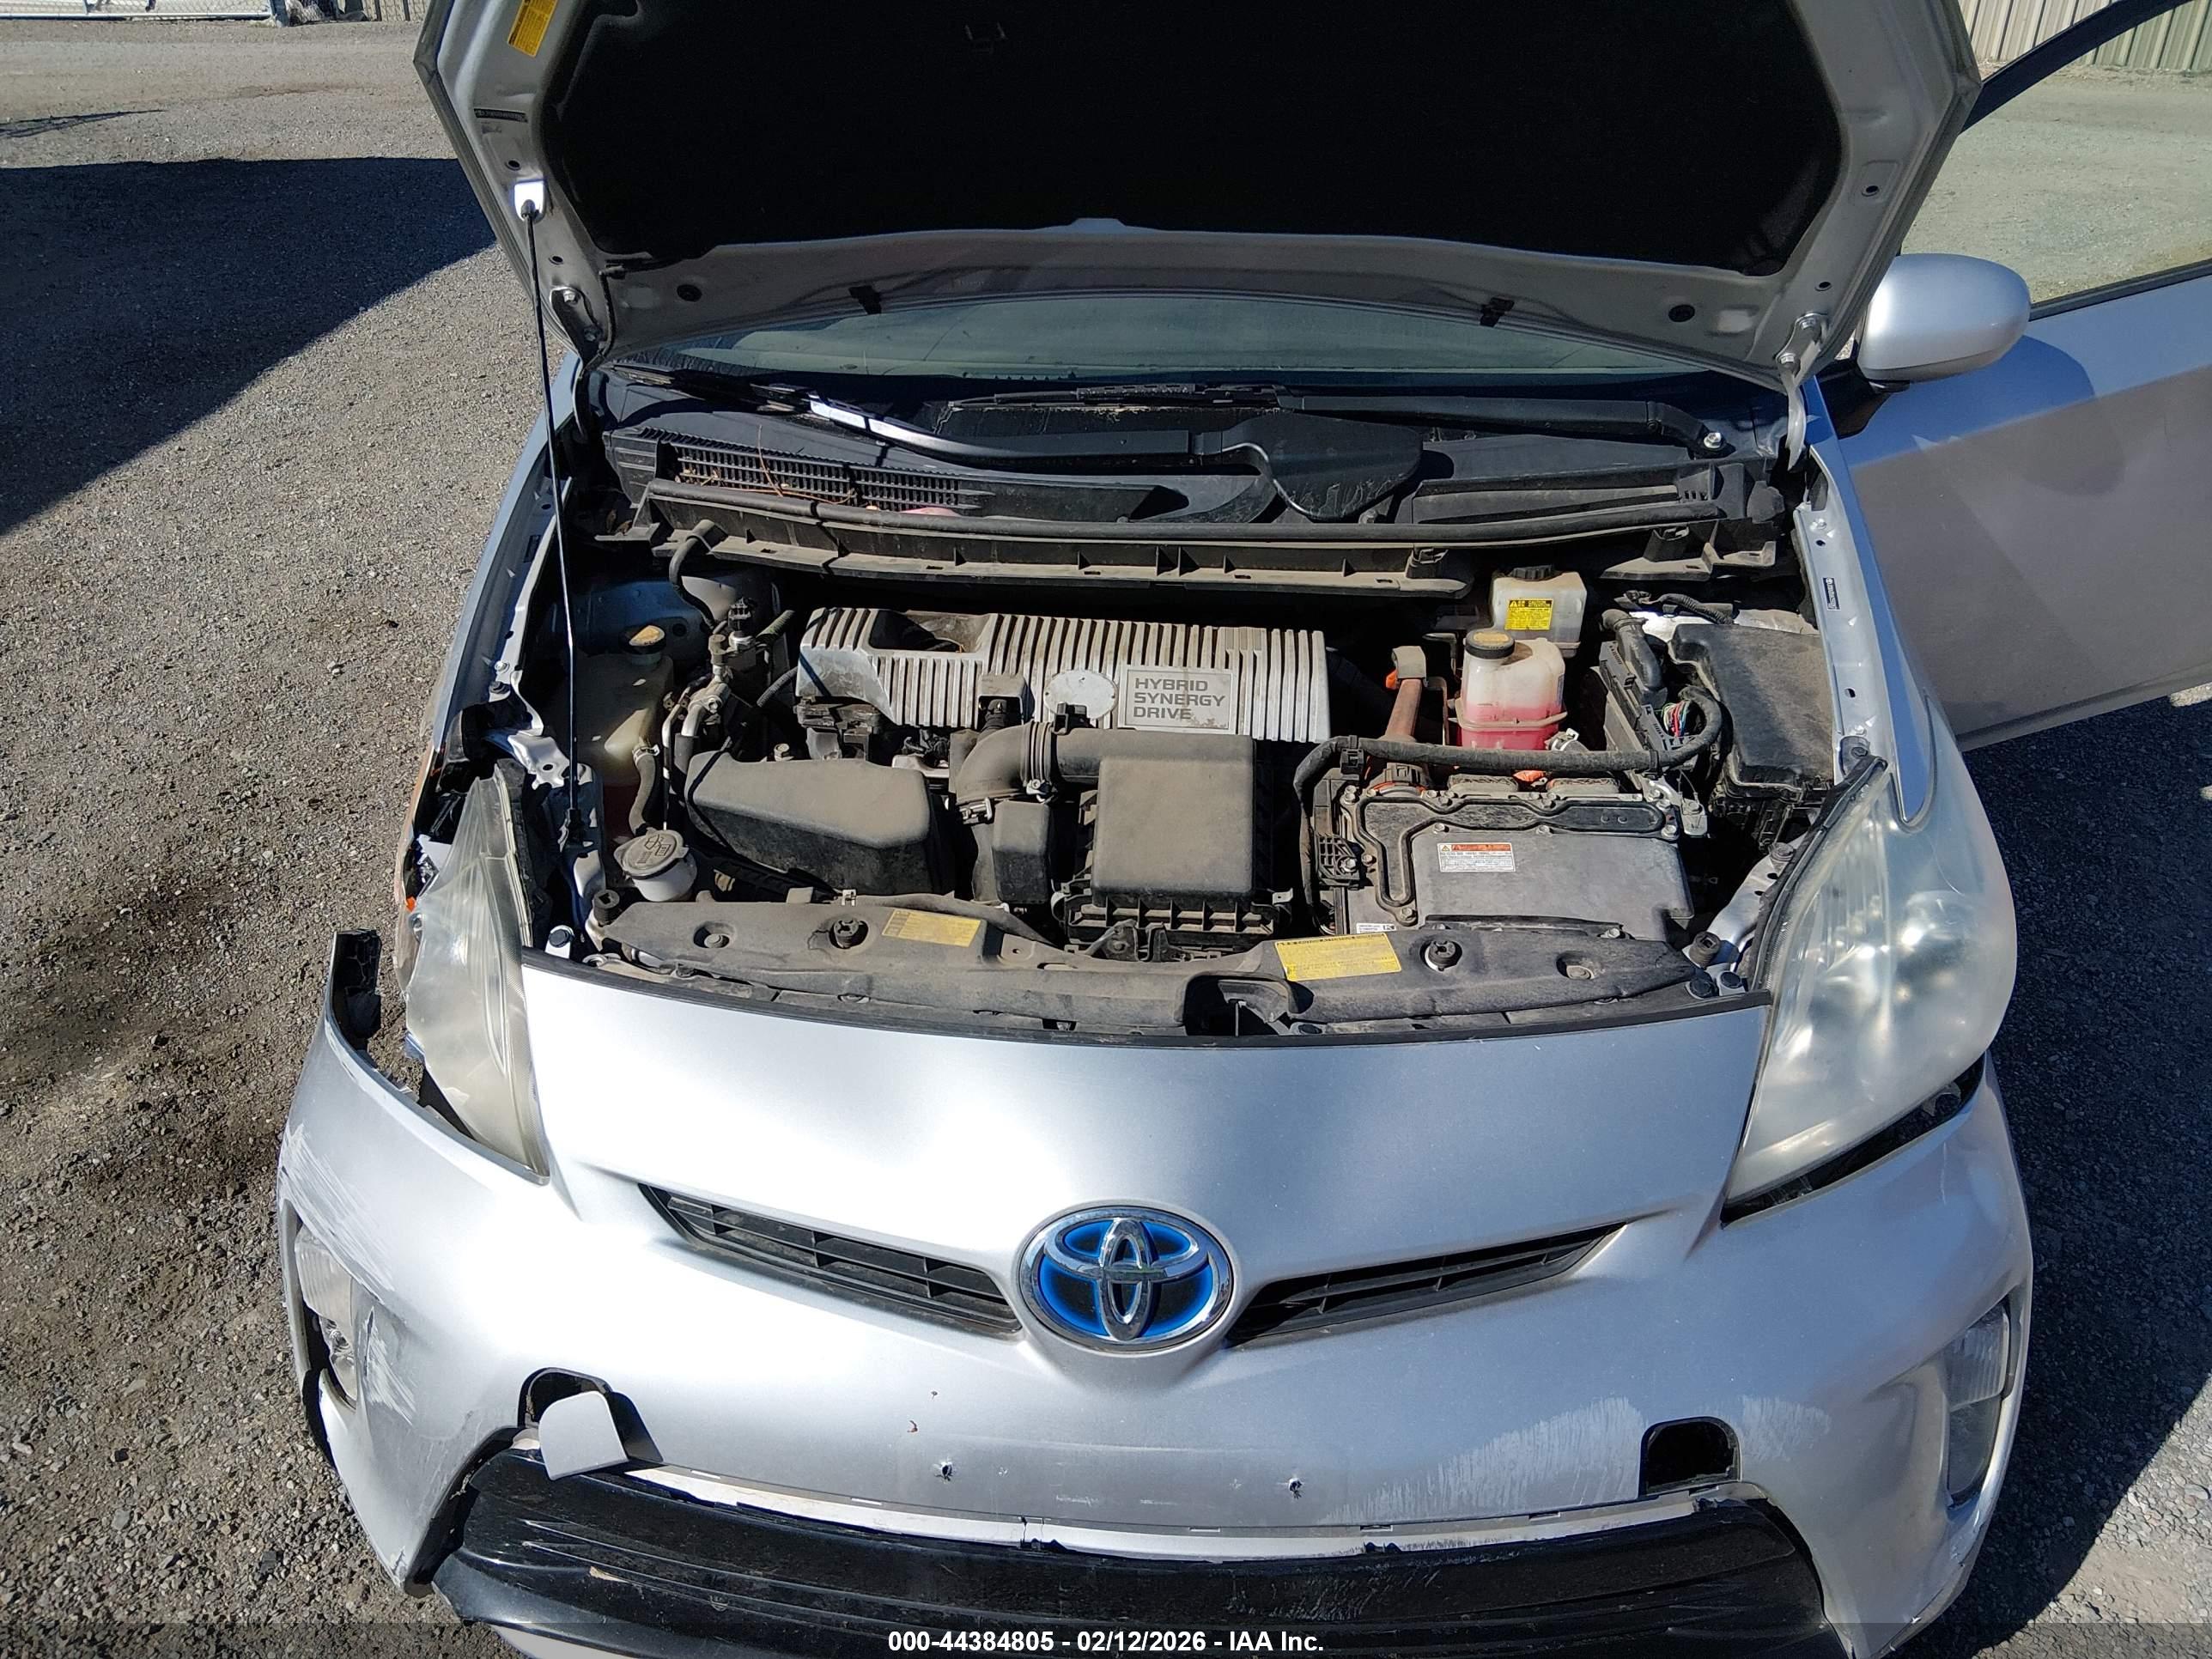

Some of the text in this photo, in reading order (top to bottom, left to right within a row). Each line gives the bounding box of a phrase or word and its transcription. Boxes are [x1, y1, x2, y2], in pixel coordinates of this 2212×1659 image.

[1134, 678, 1208, 692] HYBRID
[1133, 692, 1226, 707] SYNERGY
[1133, 706, 1192, 720] DRIVE
